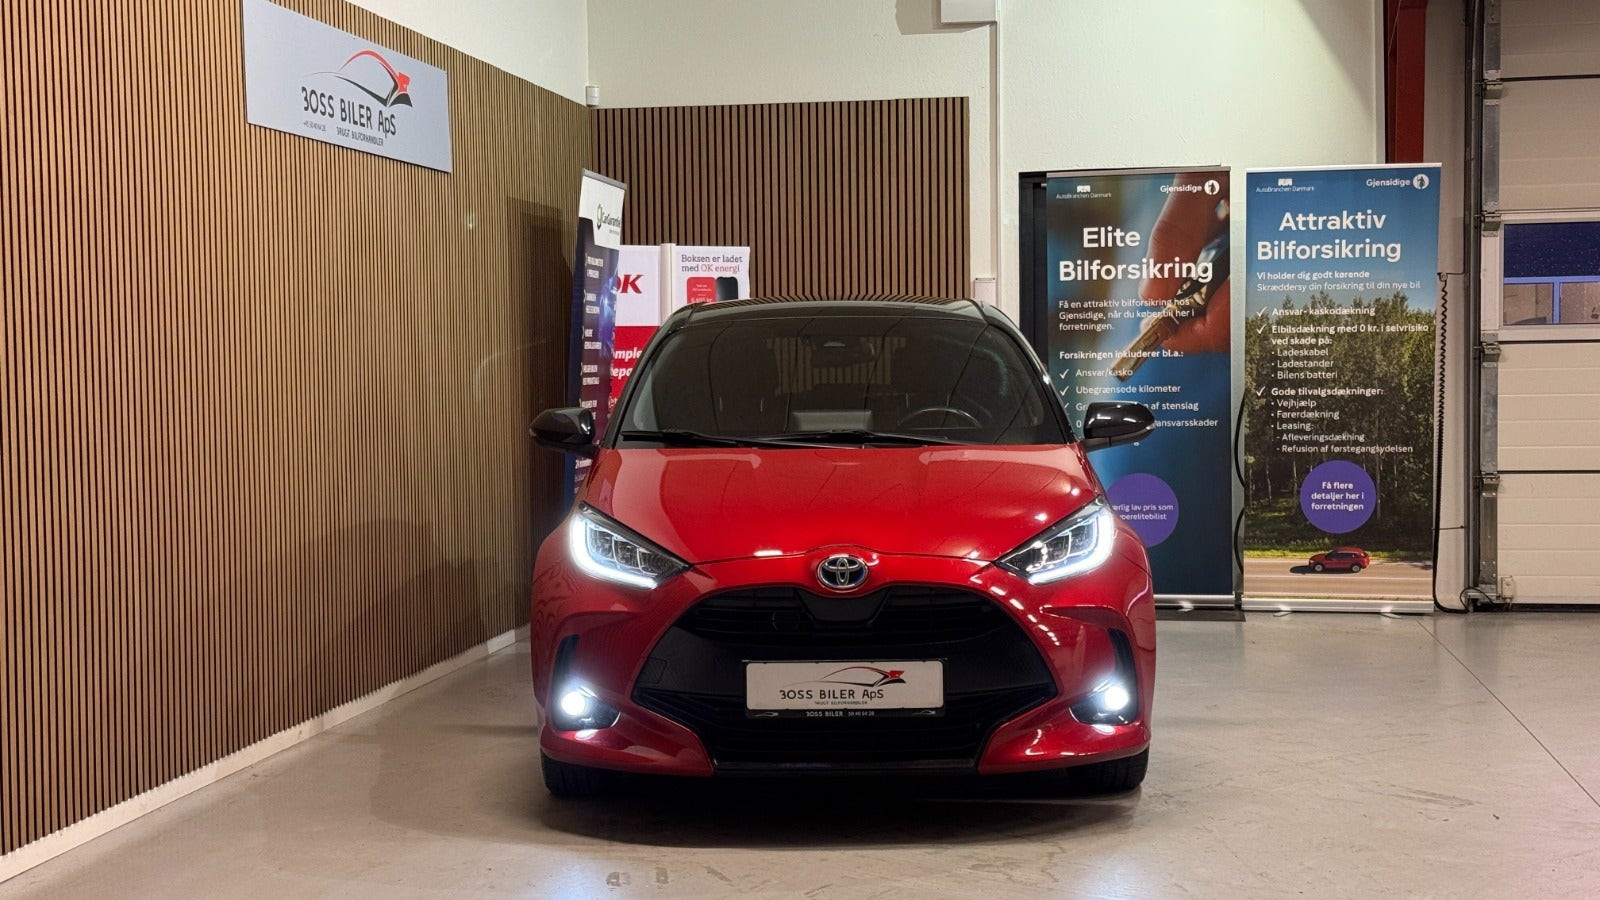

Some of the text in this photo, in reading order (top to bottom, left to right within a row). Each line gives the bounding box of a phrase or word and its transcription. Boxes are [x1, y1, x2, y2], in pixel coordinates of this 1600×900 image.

[340, 98, 373, 130] BILER
[378, 109, 396, 139] ApS
[1366, 178, 1410, 188] Gjensidige
[1160, 184, 1202, 193] Gjensidige
[1279, 210, 1387, 231] Attraktiv
[1083, 226, 1140, 248] Elite
[1257, 239, 1401, 262] Bilforsikring
[681, 254, 710, 263] Boksen
[722, 254, 743, 263] ladet
[681, 264, 740, 274] med OK energi
[1059, 256, 1213, 283] Bilforsikring
[1257, 270, 1370, 280] Vi holder dig godt kørende
[1257, 281, 1420, 292] Skræddersy din forsikring til din nye bil
[1059, 300, 1069, 308] Få
[1083, 300, 1120, 308] attraktiv
[1122, 298, 1172, 308] bilforsikring
[1173, 298, 1190, 306] hos
[1059, 311, 1106, 321] Gjensidige,
[1124, 310, 1135, 318] du
[1175, 309, 1189, 317] her
[1309, 307, 1376, 316] kaskodækning
[1059, 321, 1114, 331] forretningen.
[1272, 325, 1336, 334] Elbilsdækning
[1337, 324, 1357, 333] med
[1360, 324, 1366, 332] 0
[1367, 324, 1380, 332] kr.
[1386, 323, 1429, 332] selvrisiko
[1271, 337, 1288, 345] ved
[1290, 336, 1317, 345] skade
[1059, 351, 1113, 360] Forsikringen
[1115, 350, 1160, 359] inkluderer
[1277, 348, 1329, 356] Ladeskabel
[1277, 360, 1334, 368] Ladestander
[1075, 368, 1133, 377] Ansvar/kasko
[1277, 370, 1338, 379] Bilens batteri
[1076, 384, 1182, 395] Ubegrænsede kilometer
[1271, 387, 1296, 396] Gode
[1151, 402, 1160, 410] af
[1162, 402, 1199, 411] stenslag
[1277, 399, 1317, 409] Vejhjælp
[1277, 410, 1340, 420] Førerdækning
[1282, 433, 1365, 442] Afleveringsdækning
[1282, 445, 1318, 453] Refusion
[1320, 444, 1329, 453] af
[1322, 481, 1354, 489] Få flere
[1311, 492, 1344, 501] detaljer
[1345, 492, 1360, 500] her
[1143, 504, 1157, 512] pris
[1311, 502, 1364, 511] forretningen
[819, 689, 855, 699] BILER
[862, 689, 884, 700] ApS
